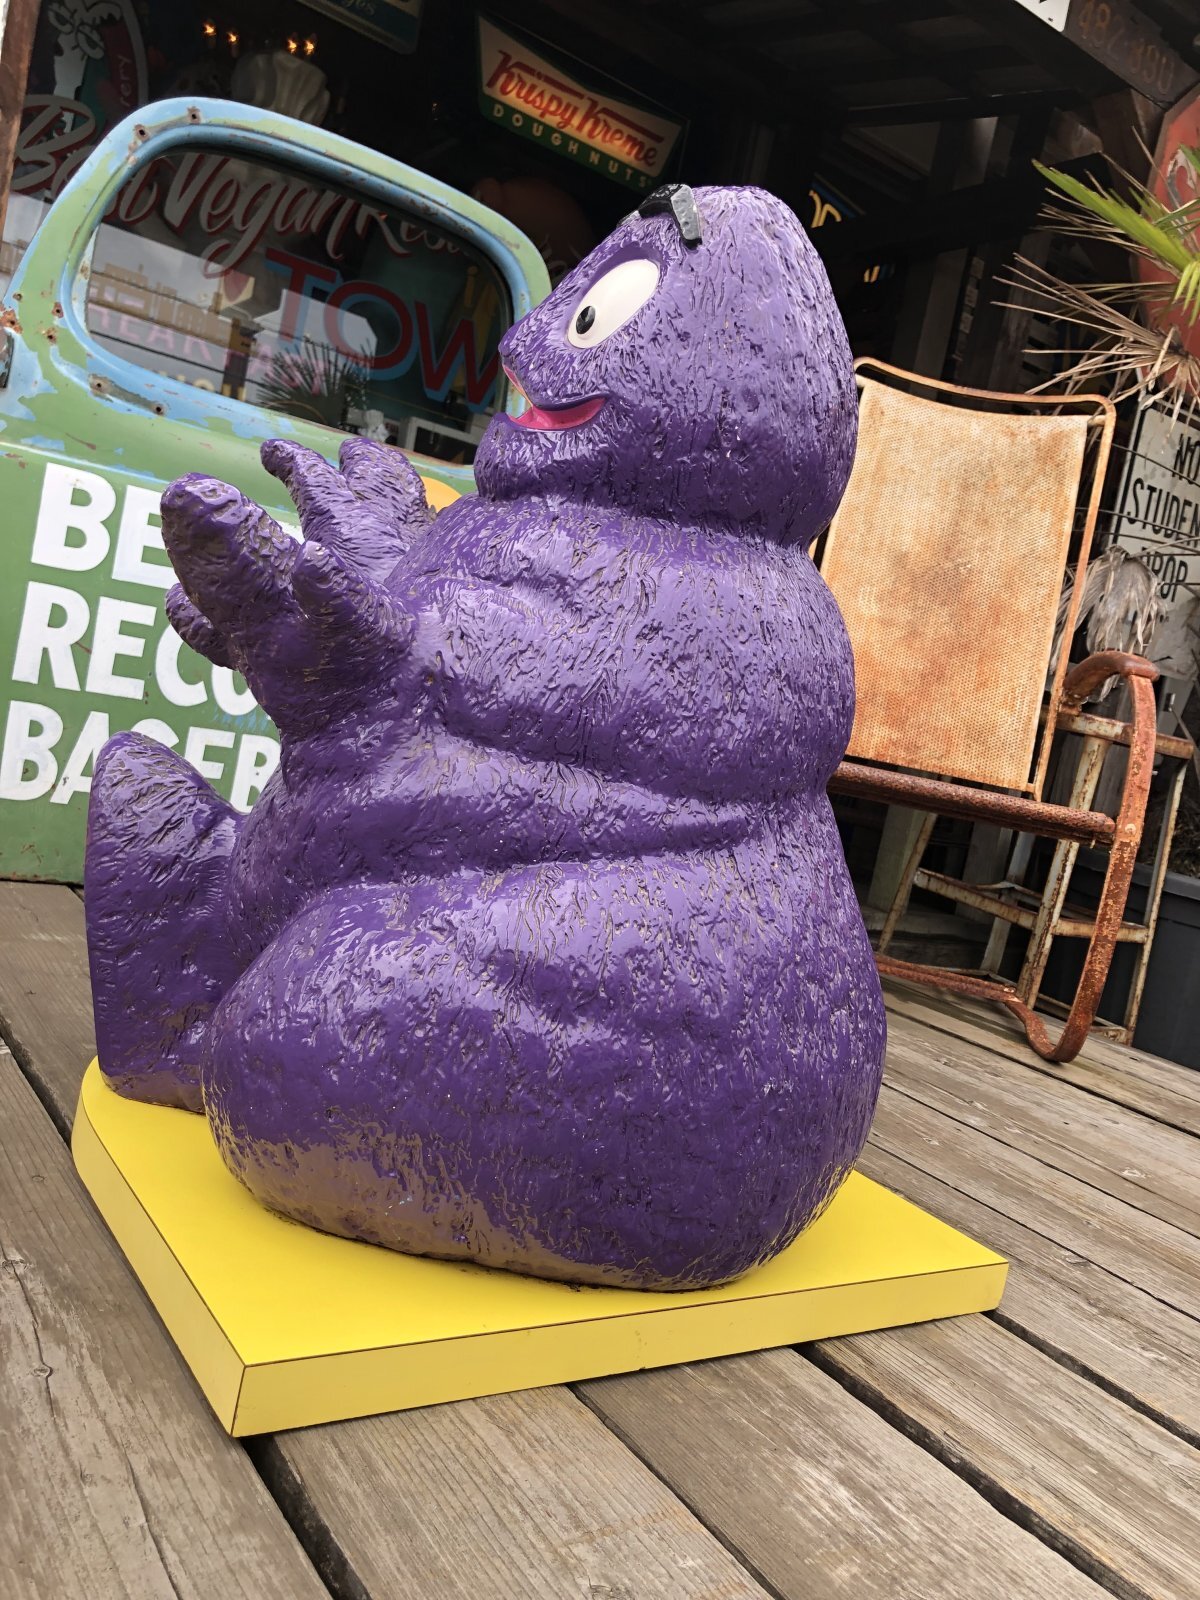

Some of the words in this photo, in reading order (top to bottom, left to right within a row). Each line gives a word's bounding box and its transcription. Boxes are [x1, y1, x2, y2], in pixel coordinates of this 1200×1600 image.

[486, 50, 585, 130] Krispy
[576, 96, 665, 167] Kreme
[492, 104, 648, 188] DOUGHNUTS
[1126, 477, 1200, 551] STUDEN
